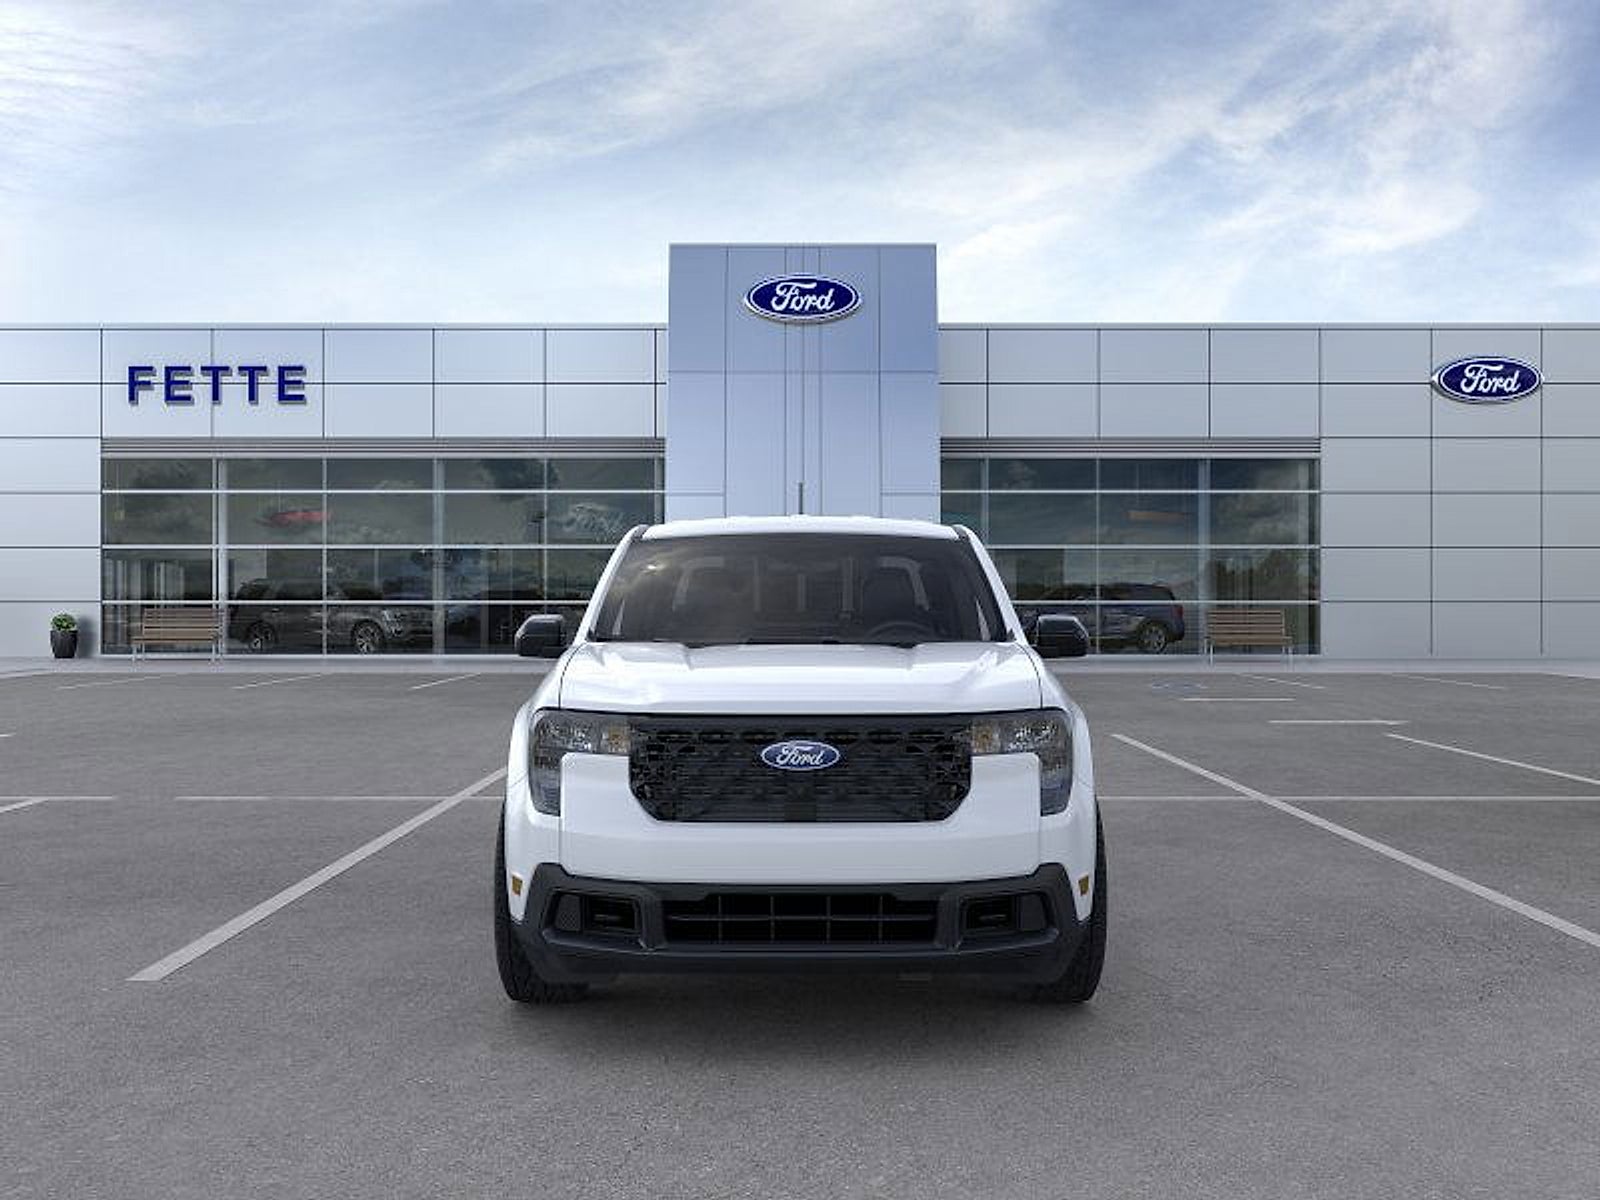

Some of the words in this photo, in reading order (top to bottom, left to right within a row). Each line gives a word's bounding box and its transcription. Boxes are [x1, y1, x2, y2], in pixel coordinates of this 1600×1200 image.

[771, 281, 835, 312] Ford
[127, 365, 307, 404] FETTE
[1460, 363, 1521, 393] Ford
[776, 744, 825, 765] Ford
